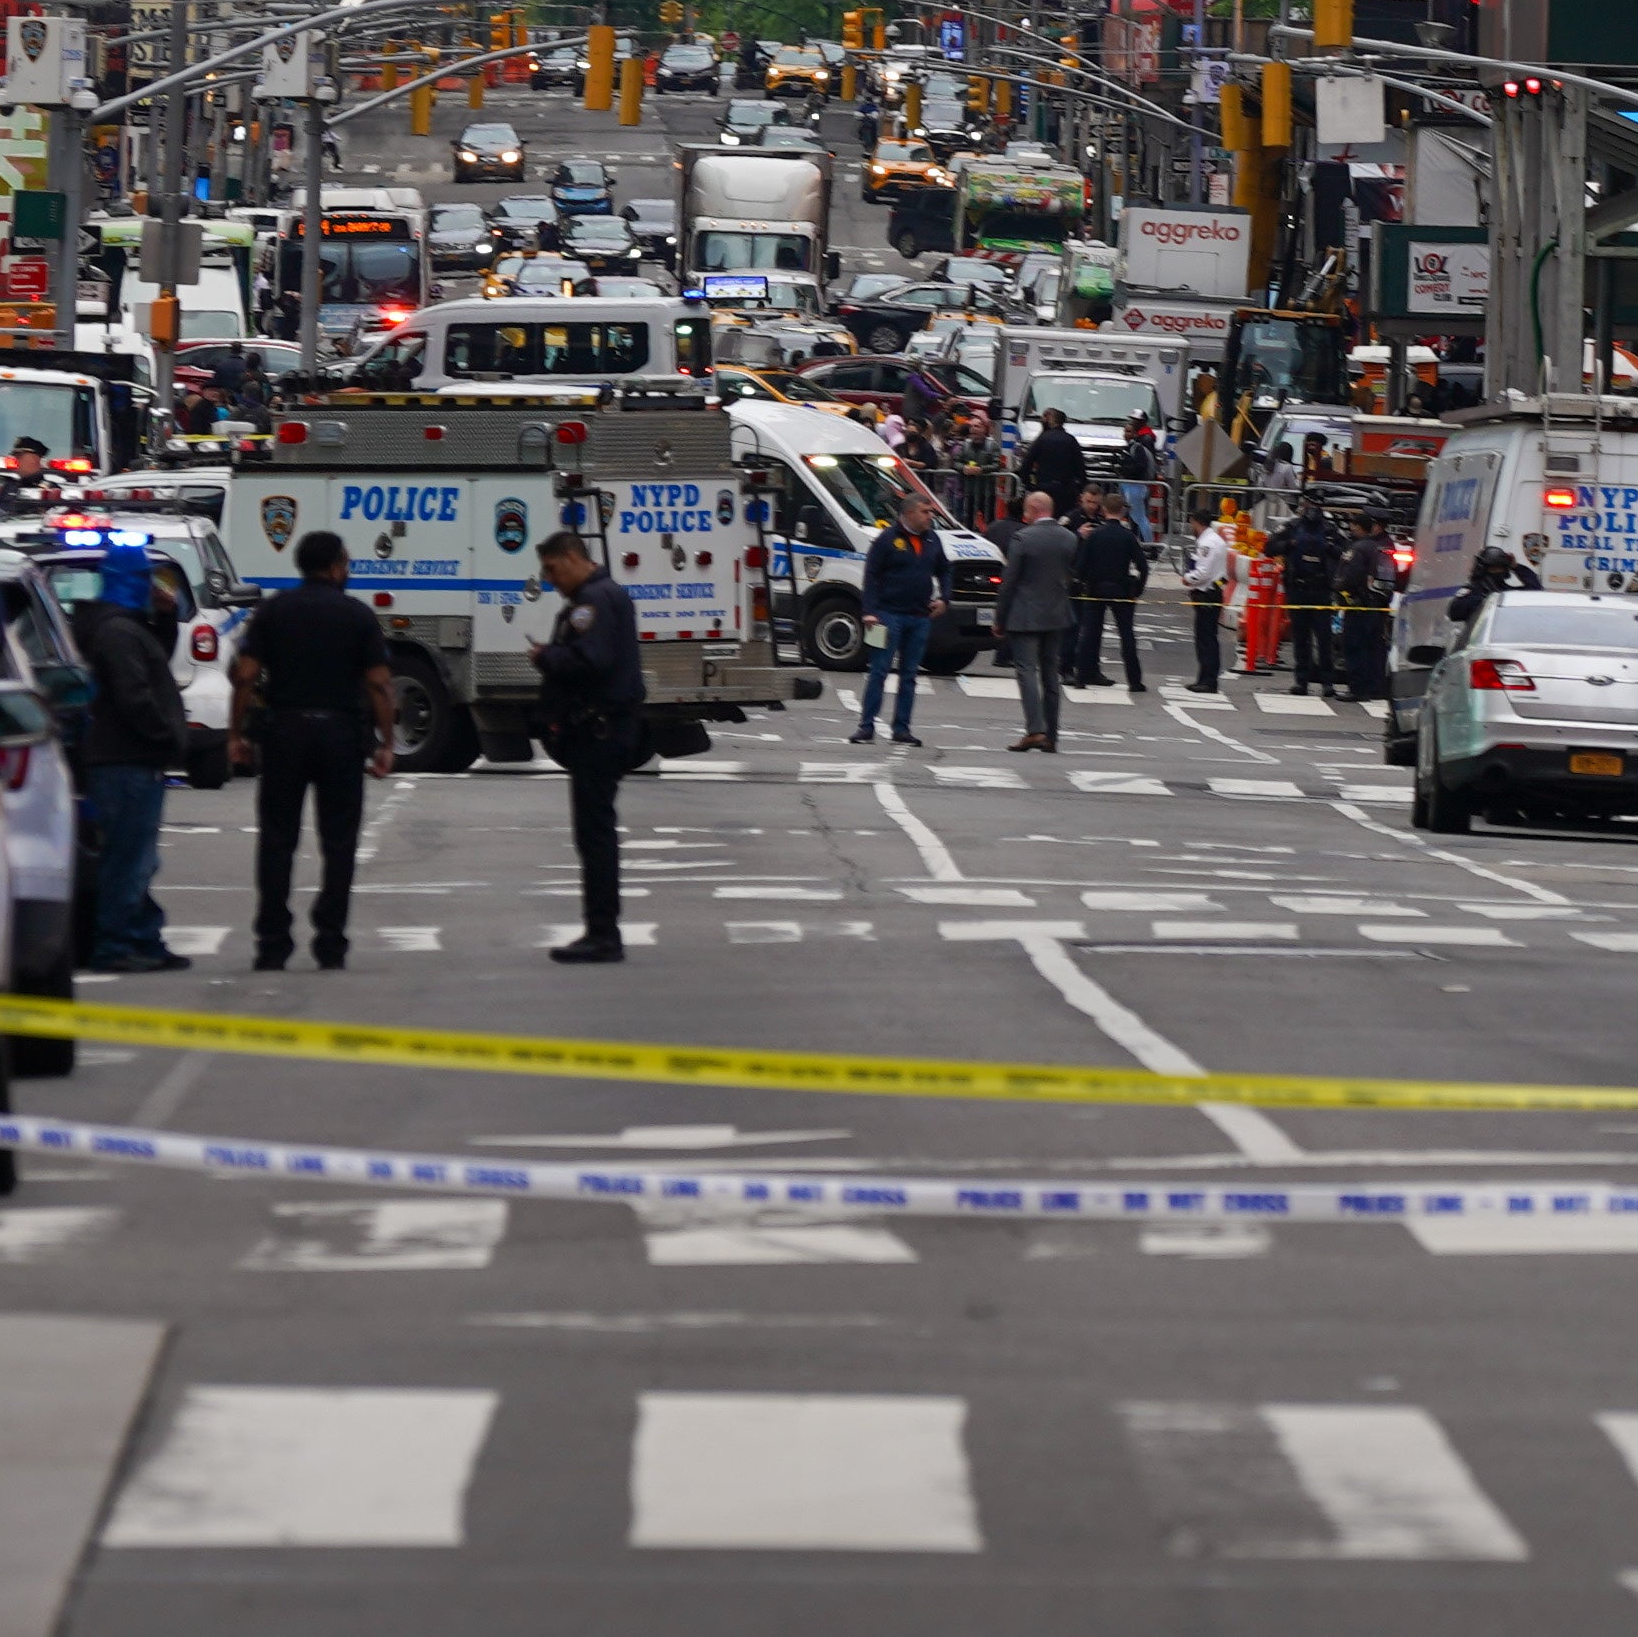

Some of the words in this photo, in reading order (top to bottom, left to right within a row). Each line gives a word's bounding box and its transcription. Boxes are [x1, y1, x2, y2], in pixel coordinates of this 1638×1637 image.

[1140, 219, 1240, 245] aggreko
[1150, 313, 1227, 333] aggreko
[339, 486, 461, 522] POLICE
[629, 483, 700, 509] NYPD
[618, 508, 714, 534] POLICE
[1561, 534, 1613, 552] REAL
